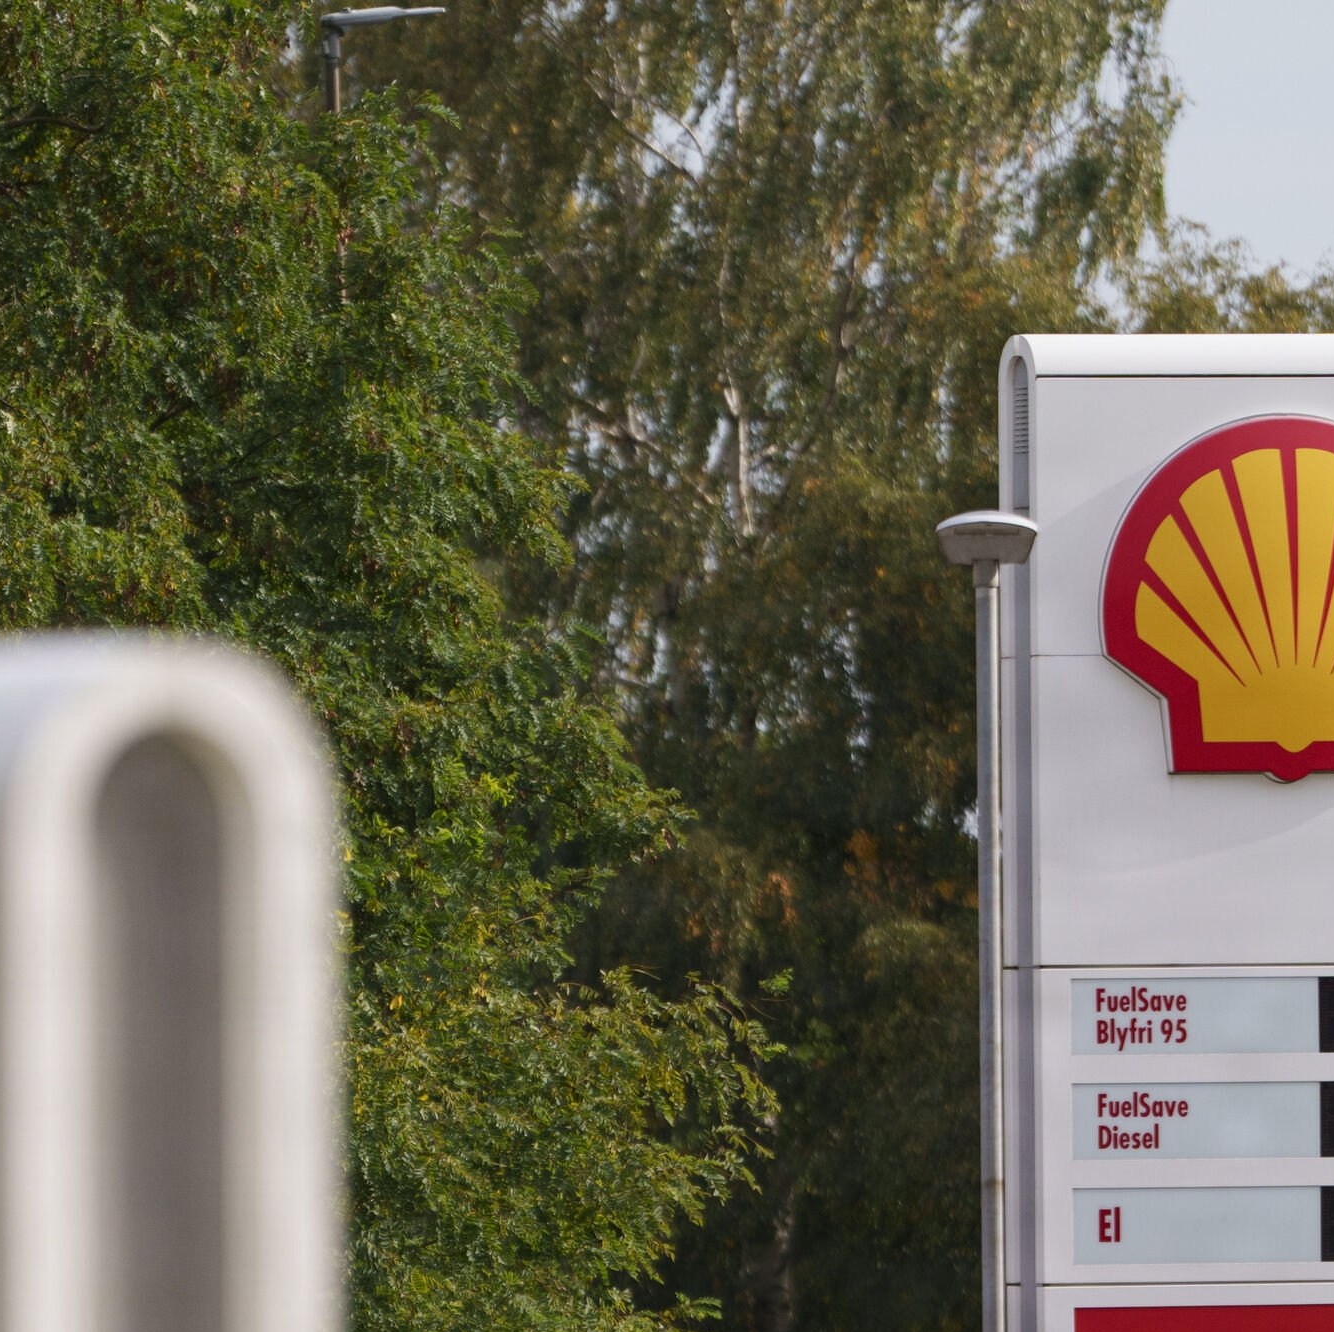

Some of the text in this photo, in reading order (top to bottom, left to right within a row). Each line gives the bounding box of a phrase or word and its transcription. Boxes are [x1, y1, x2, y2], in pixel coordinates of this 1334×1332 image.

[1095, 986, 1187, 1013] FuelSave
[1095, 1018, 1187, 1051] Blyfri 95
[1097, 1092, 1189, 1118] FuelSave
[1097, 1124, 1160, 1150] Diesel
